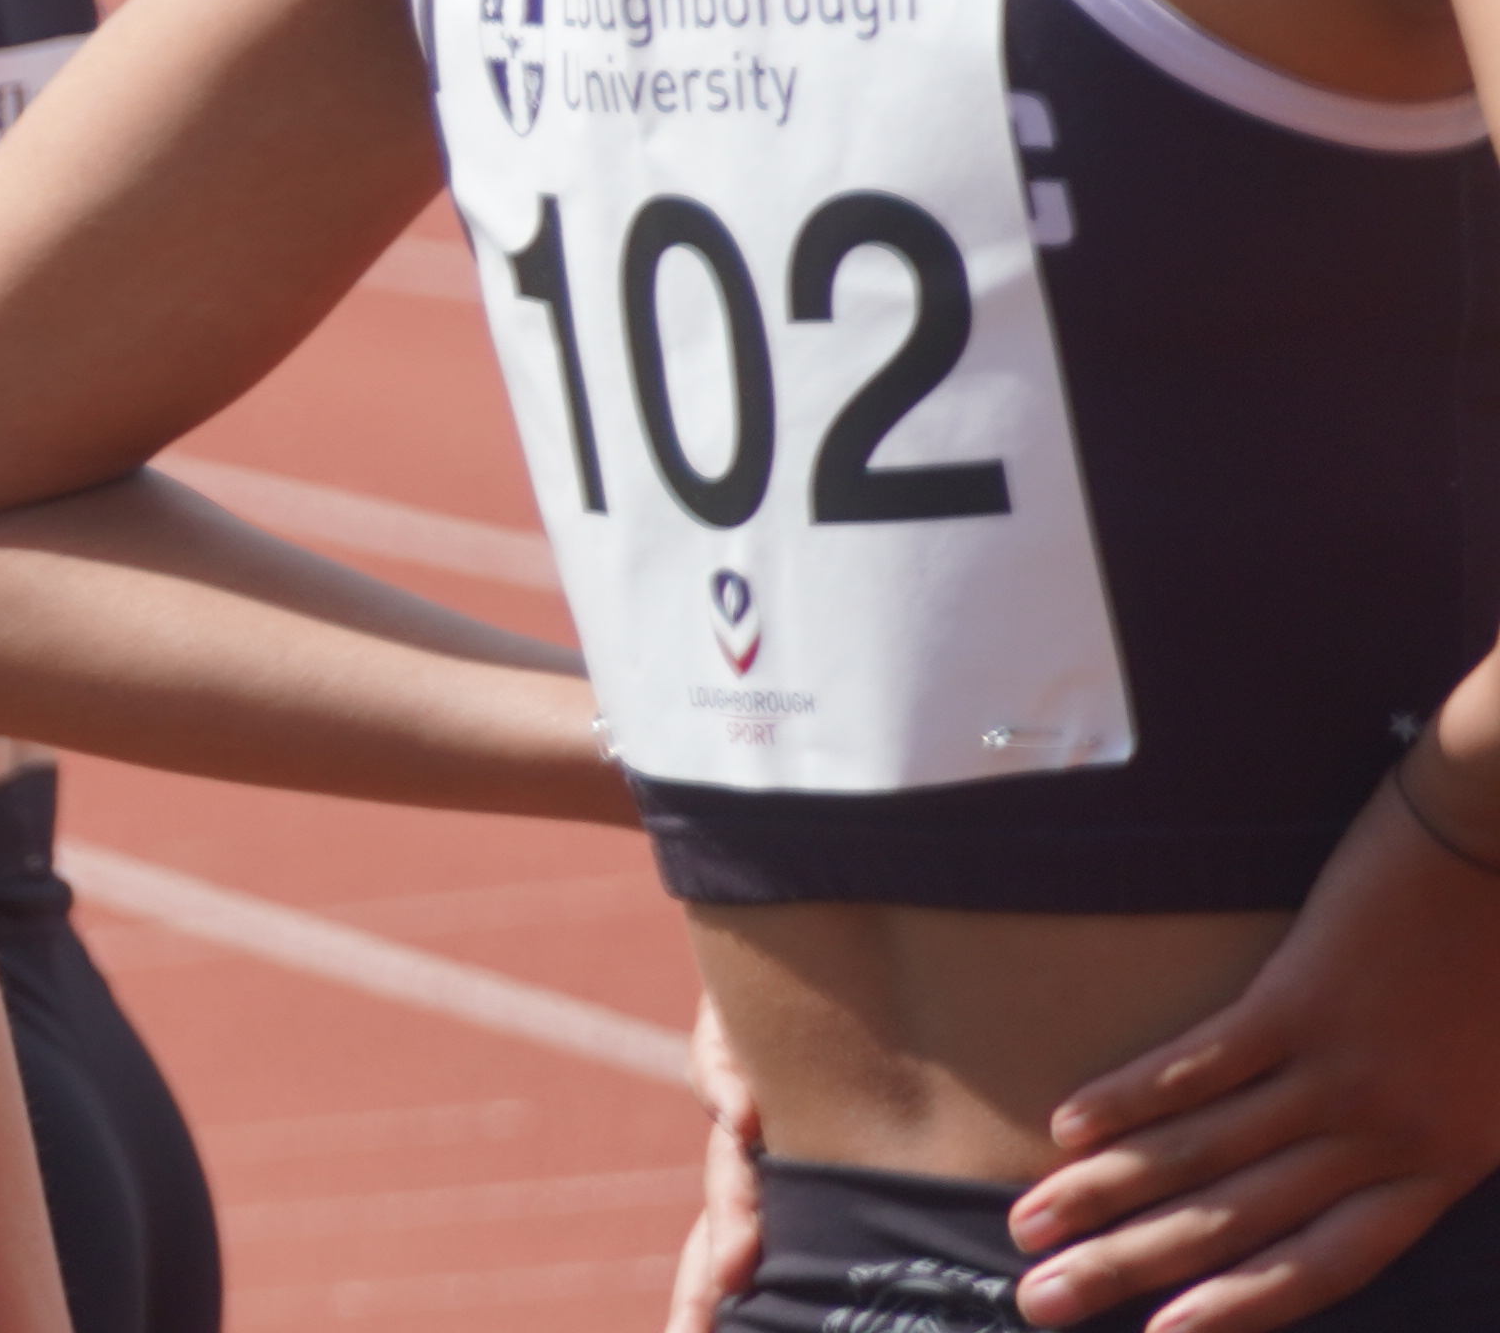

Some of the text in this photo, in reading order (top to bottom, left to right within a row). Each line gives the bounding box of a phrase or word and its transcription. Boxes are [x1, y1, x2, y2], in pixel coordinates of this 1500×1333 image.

[562, 51, 798, 126] University
[509, 188, 1013, 531] 102
[687, 686, 816, 714] LOUGHBOROUGH
[726, 721, 776, 746] SPORT
